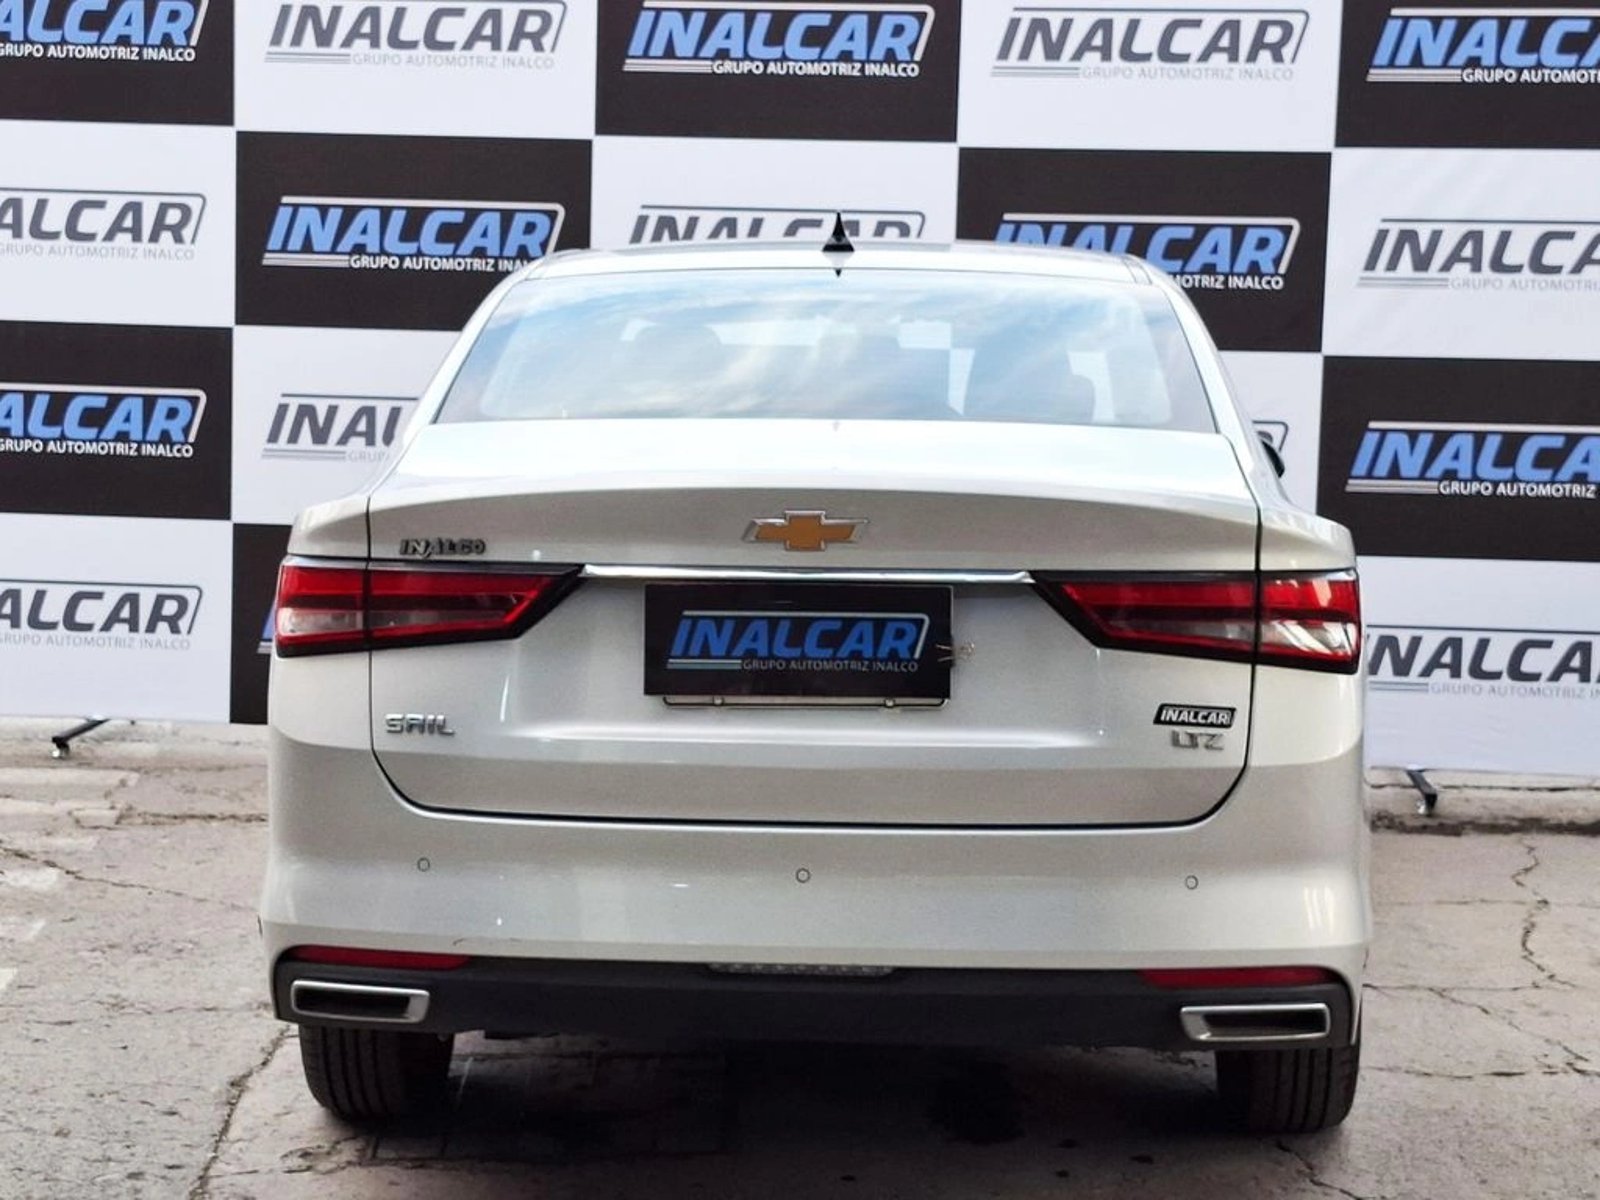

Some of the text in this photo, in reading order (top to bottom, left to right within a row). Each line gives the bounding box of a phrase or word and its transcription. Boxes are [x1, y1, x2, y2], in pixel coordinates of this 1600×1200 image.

[269, 4, 552, 52] INALCAR
[628, 10, 920, 61] INALCAR
[996, 17, 1294, 63] INALCAR
[47, 45, 139, 60] AUTOMOTRIZ
[143, 48, 196, 62] INALCO
[352, 53, 555, 69] GRUPO AUTOMOTRIZ INALCO
[712, 60, 919, 77] GRUPO AUTOMOTRIZ INALCO
[1082, 66, 1294, 81] GRUPO AUTOMOTRIZ INALCO
[1462, 69, 1600, 83] GRUPO AUTOMOT
[266, 206, 552, 258] INALCAR
[47, 245, 138, 259] AUTOMOTRIZ
[143, 247, 195, 261] INALCO
[350, 255, 399, 269] GRUPO
[403, 256, 494, 271] AUTOMOTRIZ
[1228, 275, 1284, 290] INALCO
[1450, 278, 1600, 292] GRUPO AUTOMOTRI
[47, 441, 138, 456] AUTOMOTRIZ
[141, 443, 193, 458] INALCO
[350, 452, 390, 463] GRUP
[1439, 482, 1596, 498] GRUPO AUTOMOTRIZ
[43, 635, 134, 649] AUTOMOTRIZ
[139, 638, 191, 651] INALCO
[670, 618, 917, 660] INALCAR
[743, 660, 918, 674] GRUPO AUTOMOTRIZ INALCO
[1431, 682, 1483, 695] GRUPO
[1488, 685, 1588, 699] AUTOMOTRIZ
[385, 713, 455, 736] SAIL
[1160, 709, 1228, 725] INALCAR
[1171, 730, 1224, 750] LTZ
